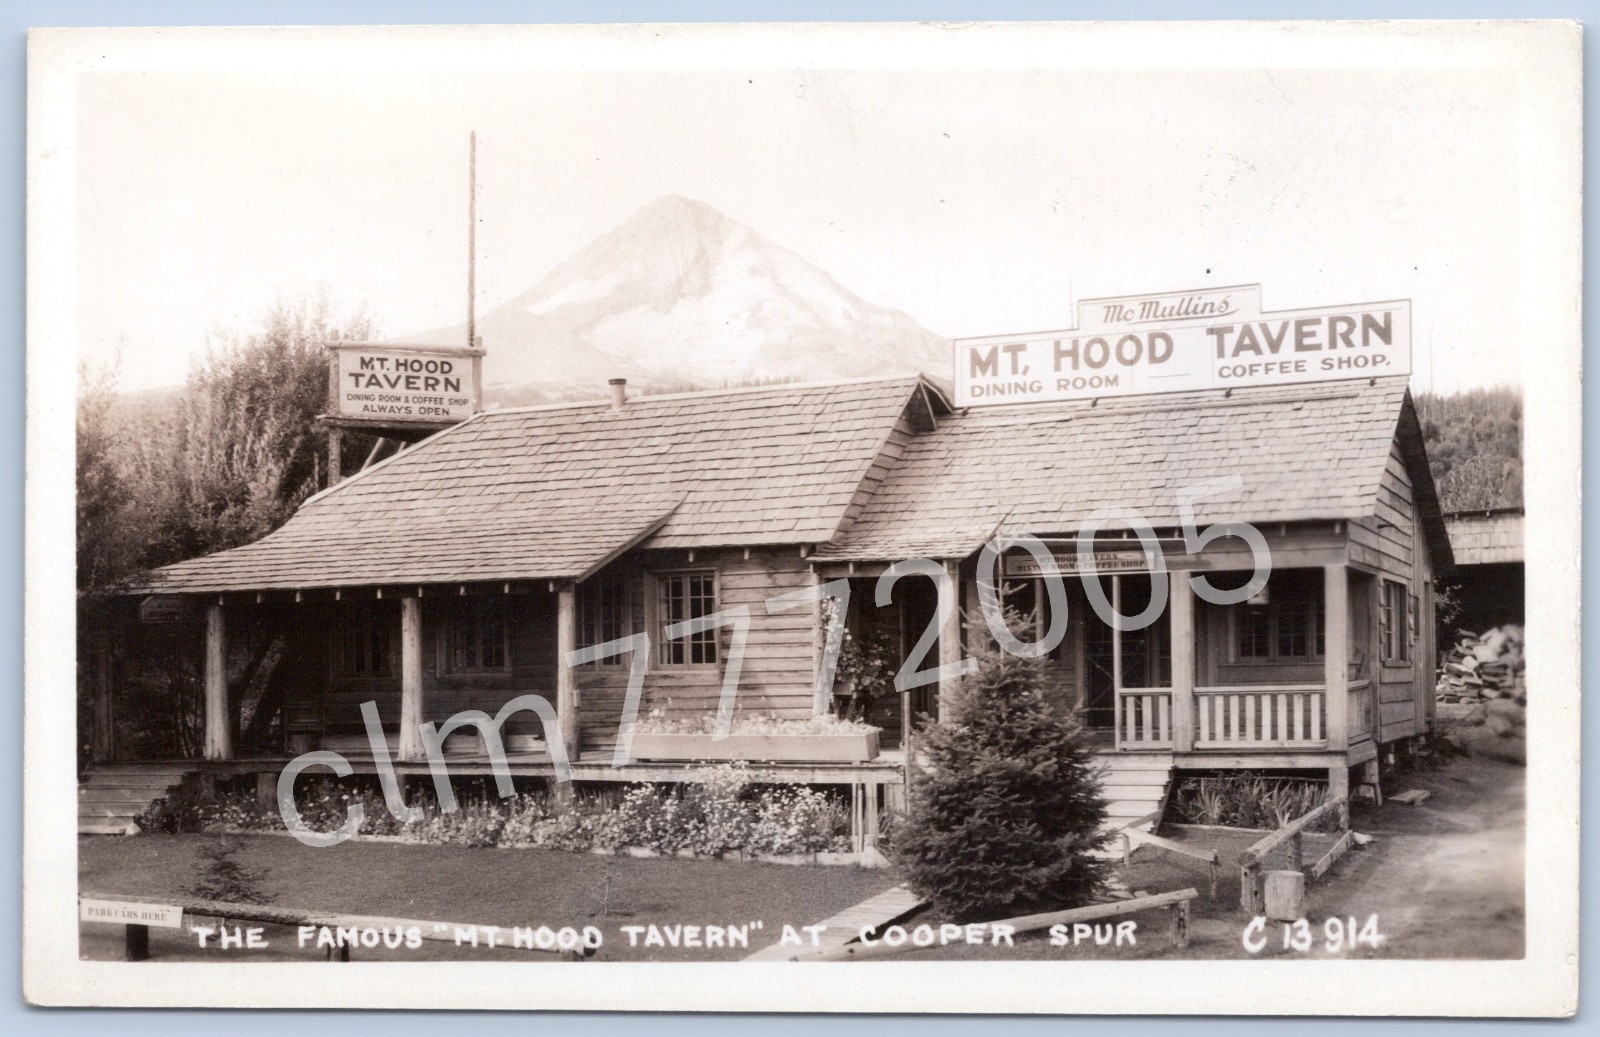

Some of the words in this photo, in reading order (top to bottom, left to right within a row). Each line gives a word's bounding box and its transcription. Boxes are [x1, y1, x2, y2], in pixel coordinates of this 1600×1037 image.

[1053, 331, 1174, 372] HOOD
[1206, 312, 1392, 359] TAVERN
[360, 356, 390, 371] MT.
[395, 358, 453, 374] HOOD
[1218, 360, 1307, 378] COFFEE
[348, 373, 461, 392] TAVERN
[971, 380, 1043, 398] DINING
[1056, 375, 1119, 391] ROOM
[347, 393, 375, 402] DINING
[378, 394, 402, 403] ROOM
[412, 395, 444, 405] COFFEE
[448, 398, 469, 406] SHOP
[362, 404, 413, 414] ALWAYS
[418, 406, 450, 416] OPEN
[88, 907, 113, 917] PARK
[114, 908, 138, 918] CARS
[141, 911, 168, 921] HERE
